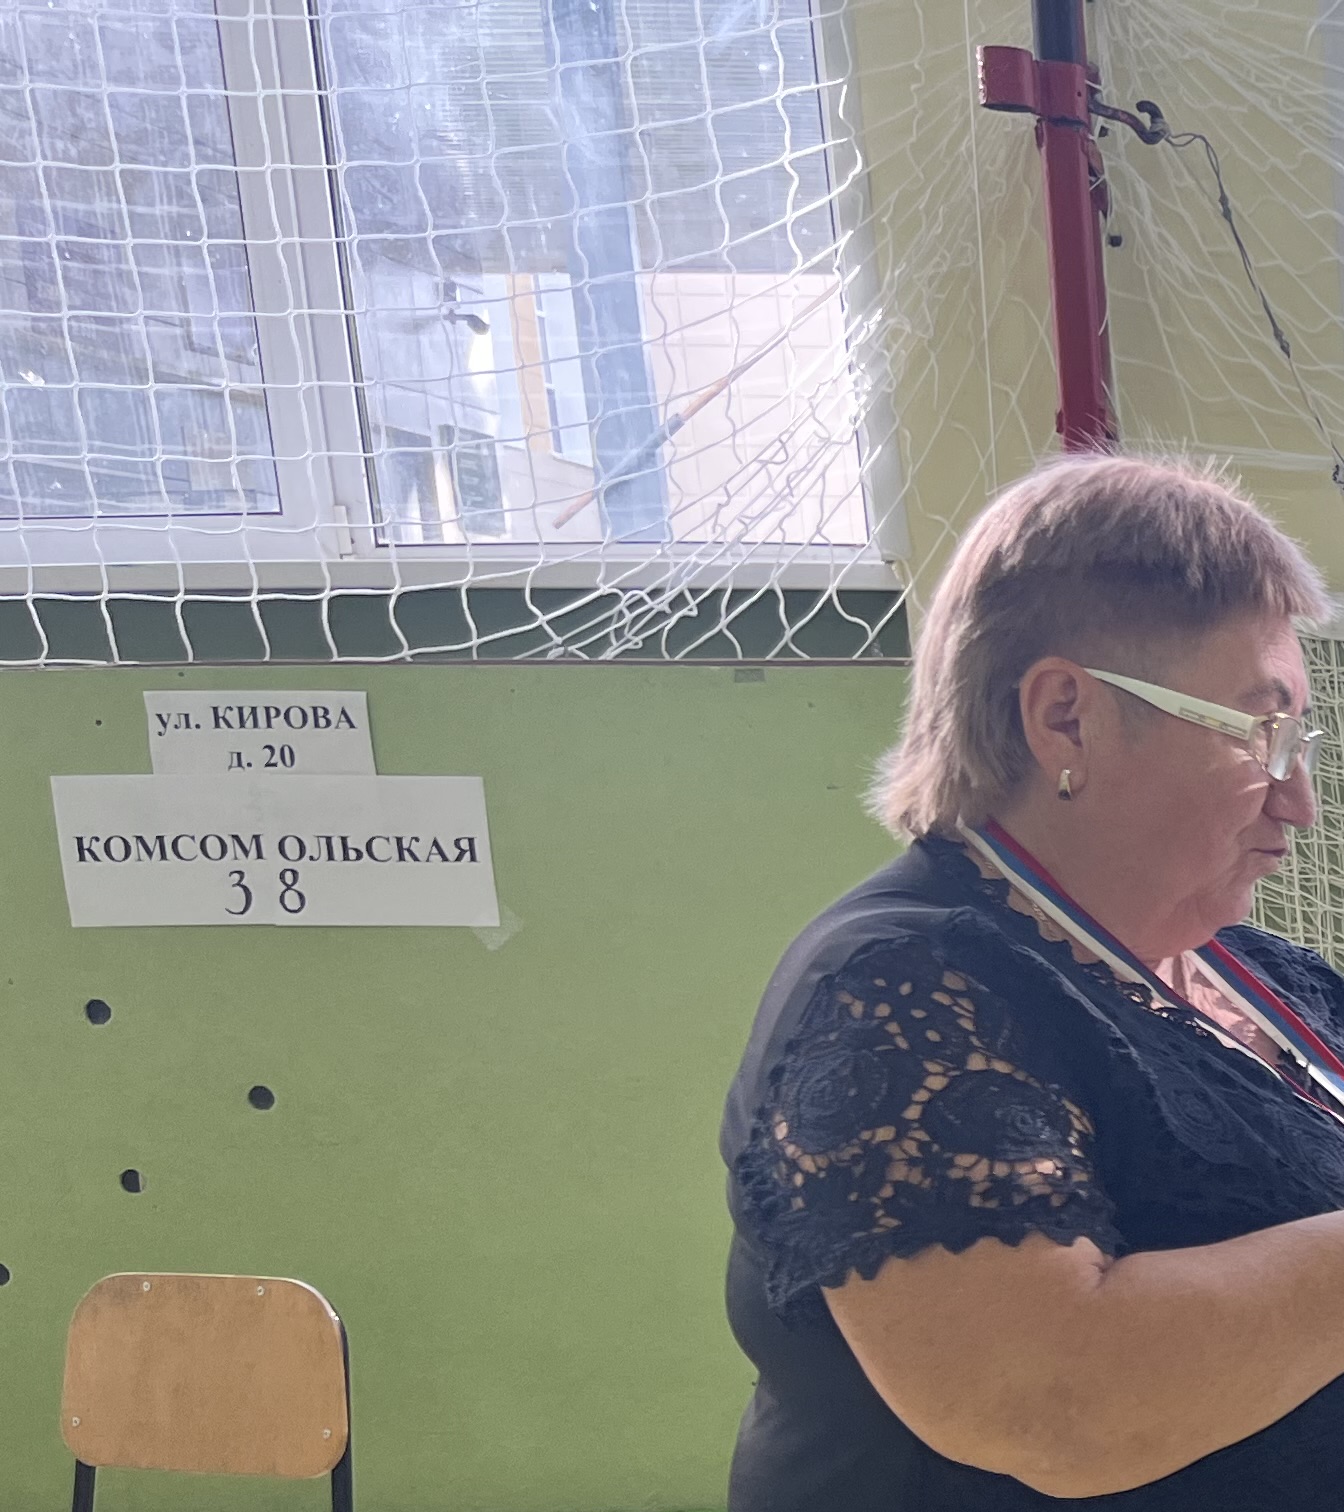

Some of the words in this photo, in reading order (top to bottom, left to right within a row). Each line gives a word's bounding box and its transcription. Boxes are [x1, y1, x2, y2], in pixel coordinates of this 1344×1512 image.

[154, 712, 201, 737] ул.
[210, 705, 357, 730] КИРОВА
[227, 751, 253, 771] д.
[262, 743, 296, 768] 20
